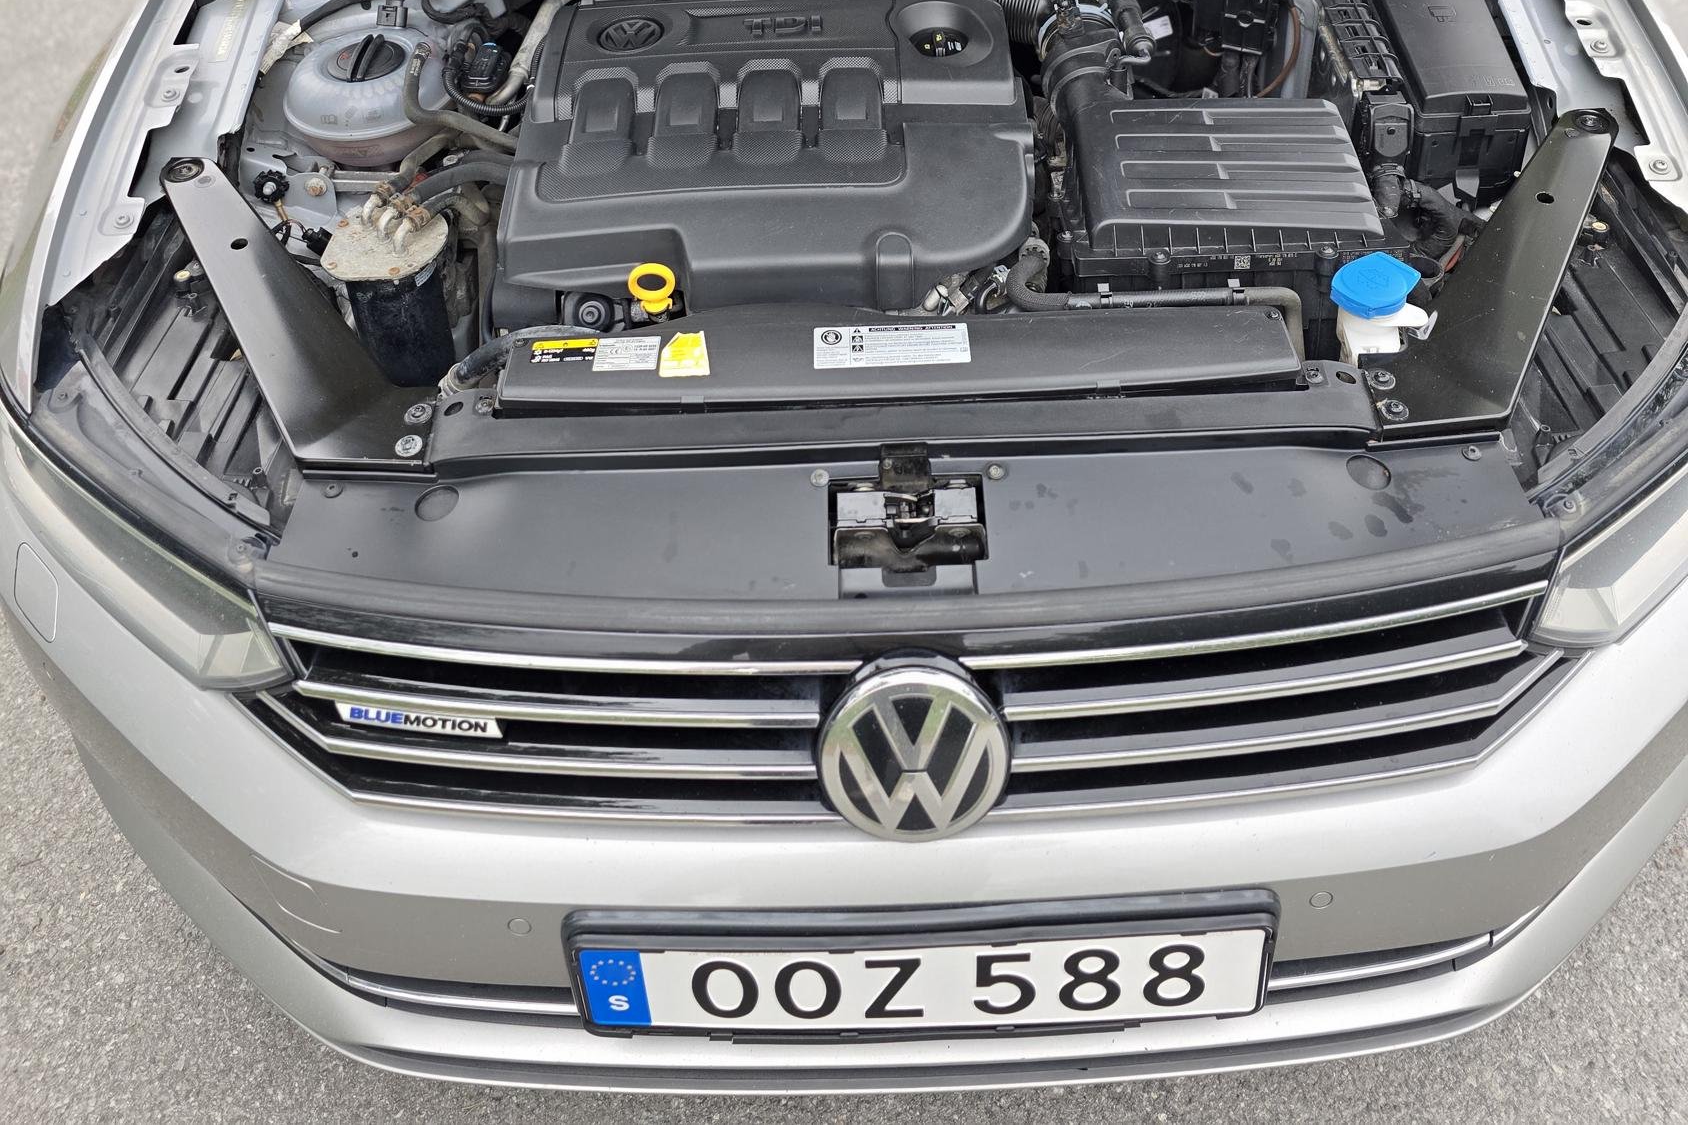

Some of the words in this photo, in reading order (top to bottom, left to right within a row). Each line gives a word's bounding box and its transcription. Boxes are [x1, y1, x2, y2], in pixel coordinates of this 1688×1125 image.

[743, 16, 822, 35] TDI
[349, 707, 488, 733] BLUEMOTION
[824, 677, 1006, 840] VW
[691, 957, 925, 1020] OOZ
[973, 943, 1206, 1015] 588
[609, 995, 630, 1013] S
